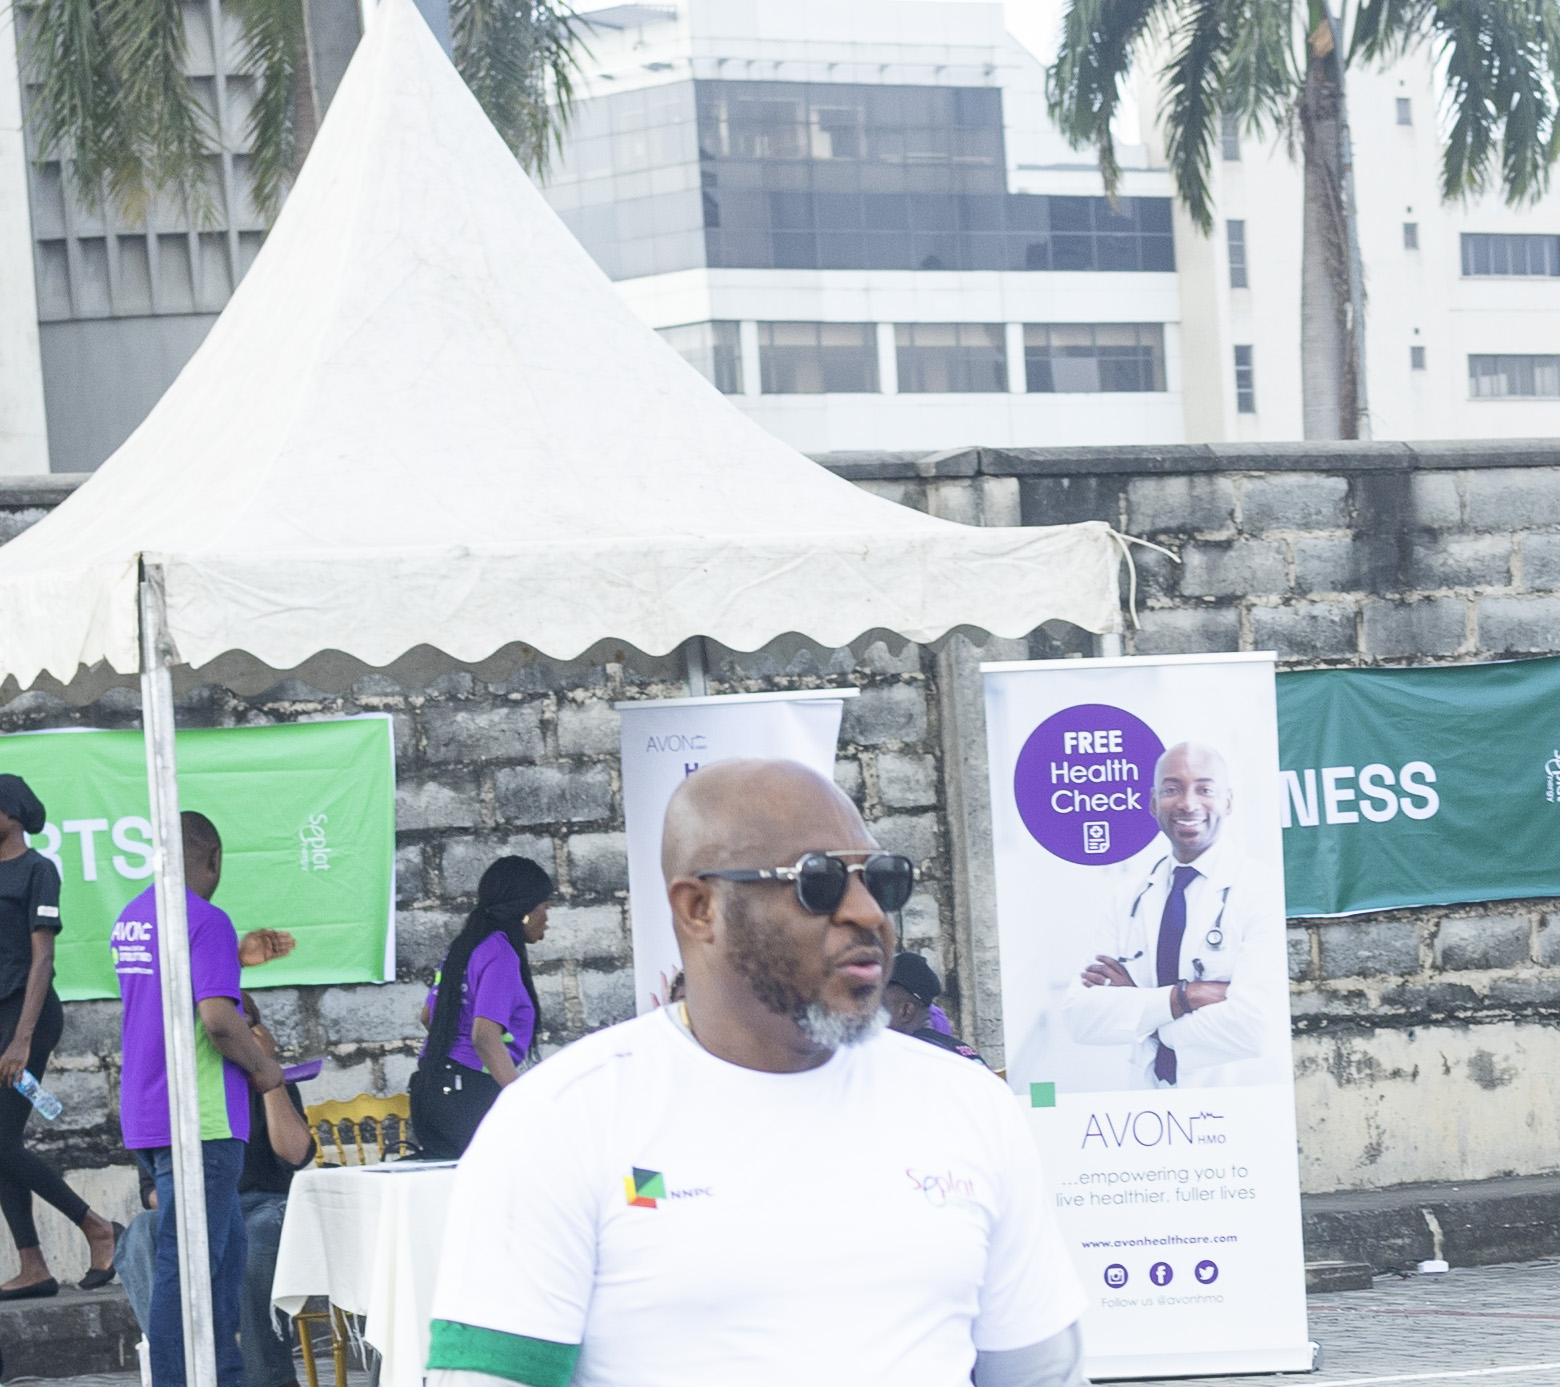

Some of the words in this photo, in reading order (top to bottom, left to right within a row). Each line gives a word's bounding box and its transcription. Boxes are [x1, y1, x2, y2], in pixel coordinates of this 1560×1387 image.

[646, 735, 696, 752] AVON
[1063, 730, 1123, 755] FREE
[1050, 758, 1140, 785] Health
[1050, 787, 1143, 814] Check
[308, 814, 332, 871] Seplat
[1081, 1110, 1193, 1149] AVON
[1198, 1135, 1227, 1145] HMO
[1194, 1167, 1226, 1181] you
[1232, 1164, 1249, 1178] to
[1056, 1192, 1085, 1207] live
[1176, 1187, 1216, 1202] fuller
[1220, 1185, 1256, 1200] lives
[1081, 1234, 1238, 1249] www.avonhealthcare.com
[1101, 1296, 1137, 1308] Follow
[1141, 1297, 1153, 1307] us
